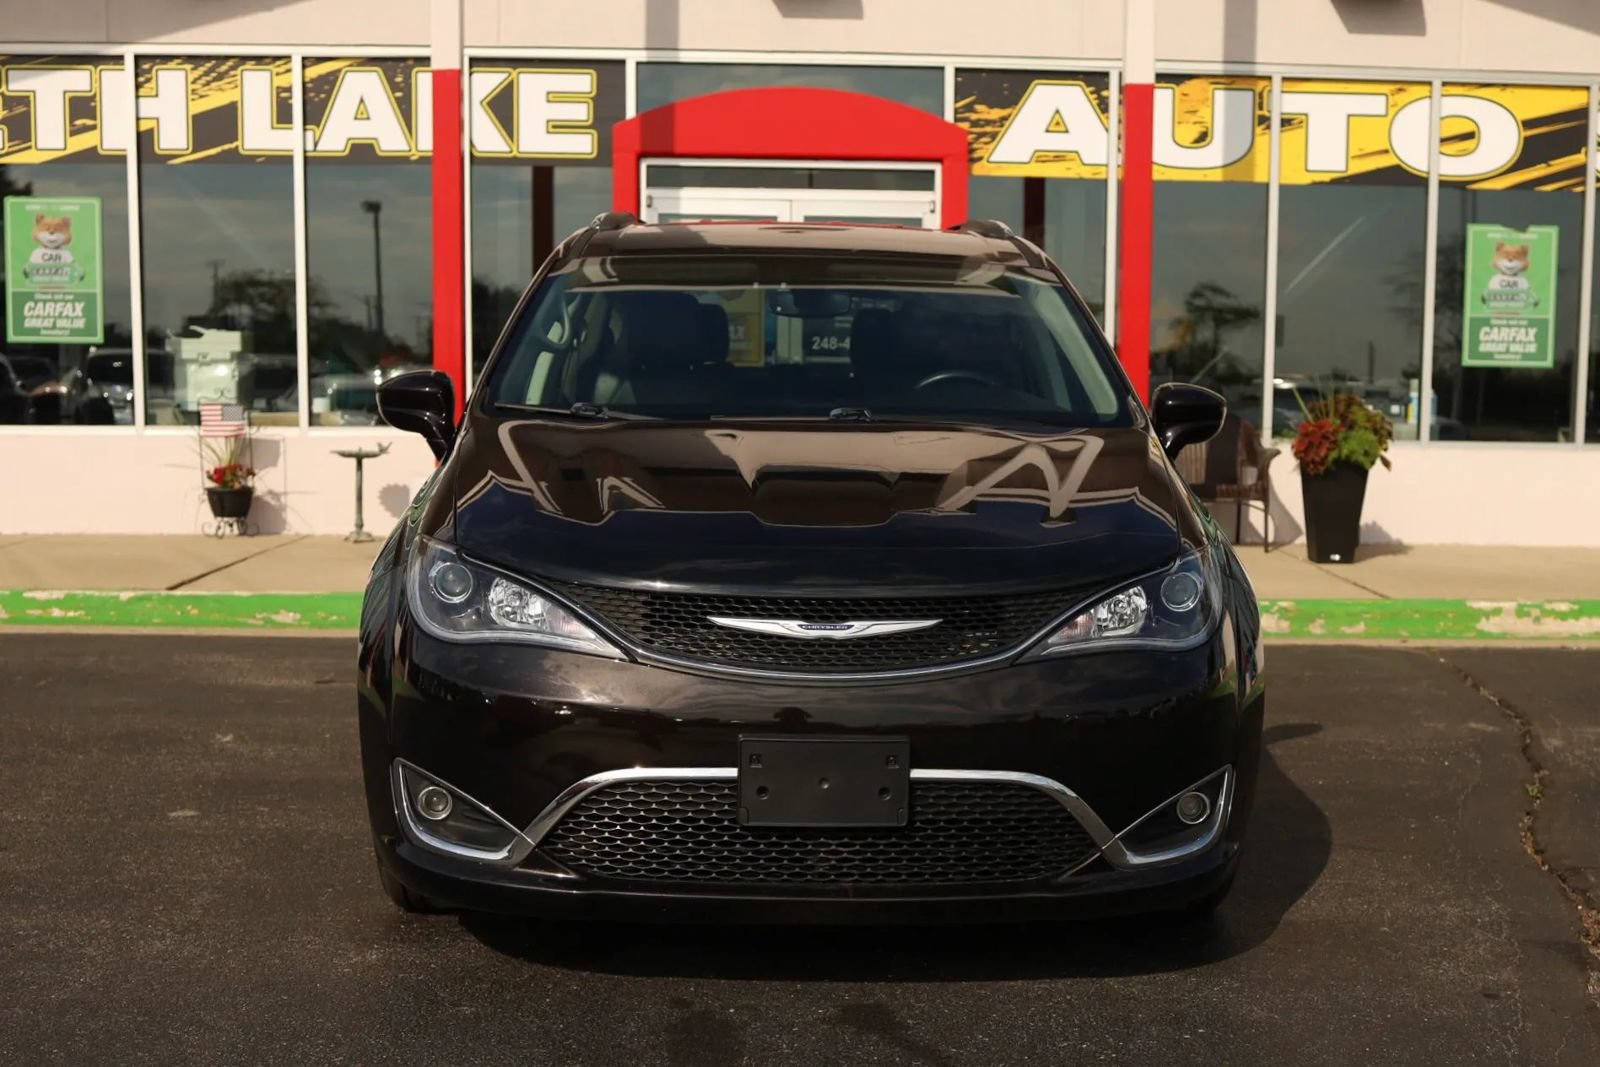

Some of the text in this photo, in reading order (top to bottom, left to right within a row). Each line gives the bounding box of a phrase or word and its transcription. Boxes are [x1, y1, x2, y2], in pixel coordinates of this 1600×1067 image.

[0, 65, 192, 154] TH
[238, 65, 597, 158] LAKE
[976, 79, 1524, 181] AUTO
[24, 301, 86, 317] CARFAX
[23, 318, 55, 328] GREAT
[1479, 326, 1537, 342] CARFAX
